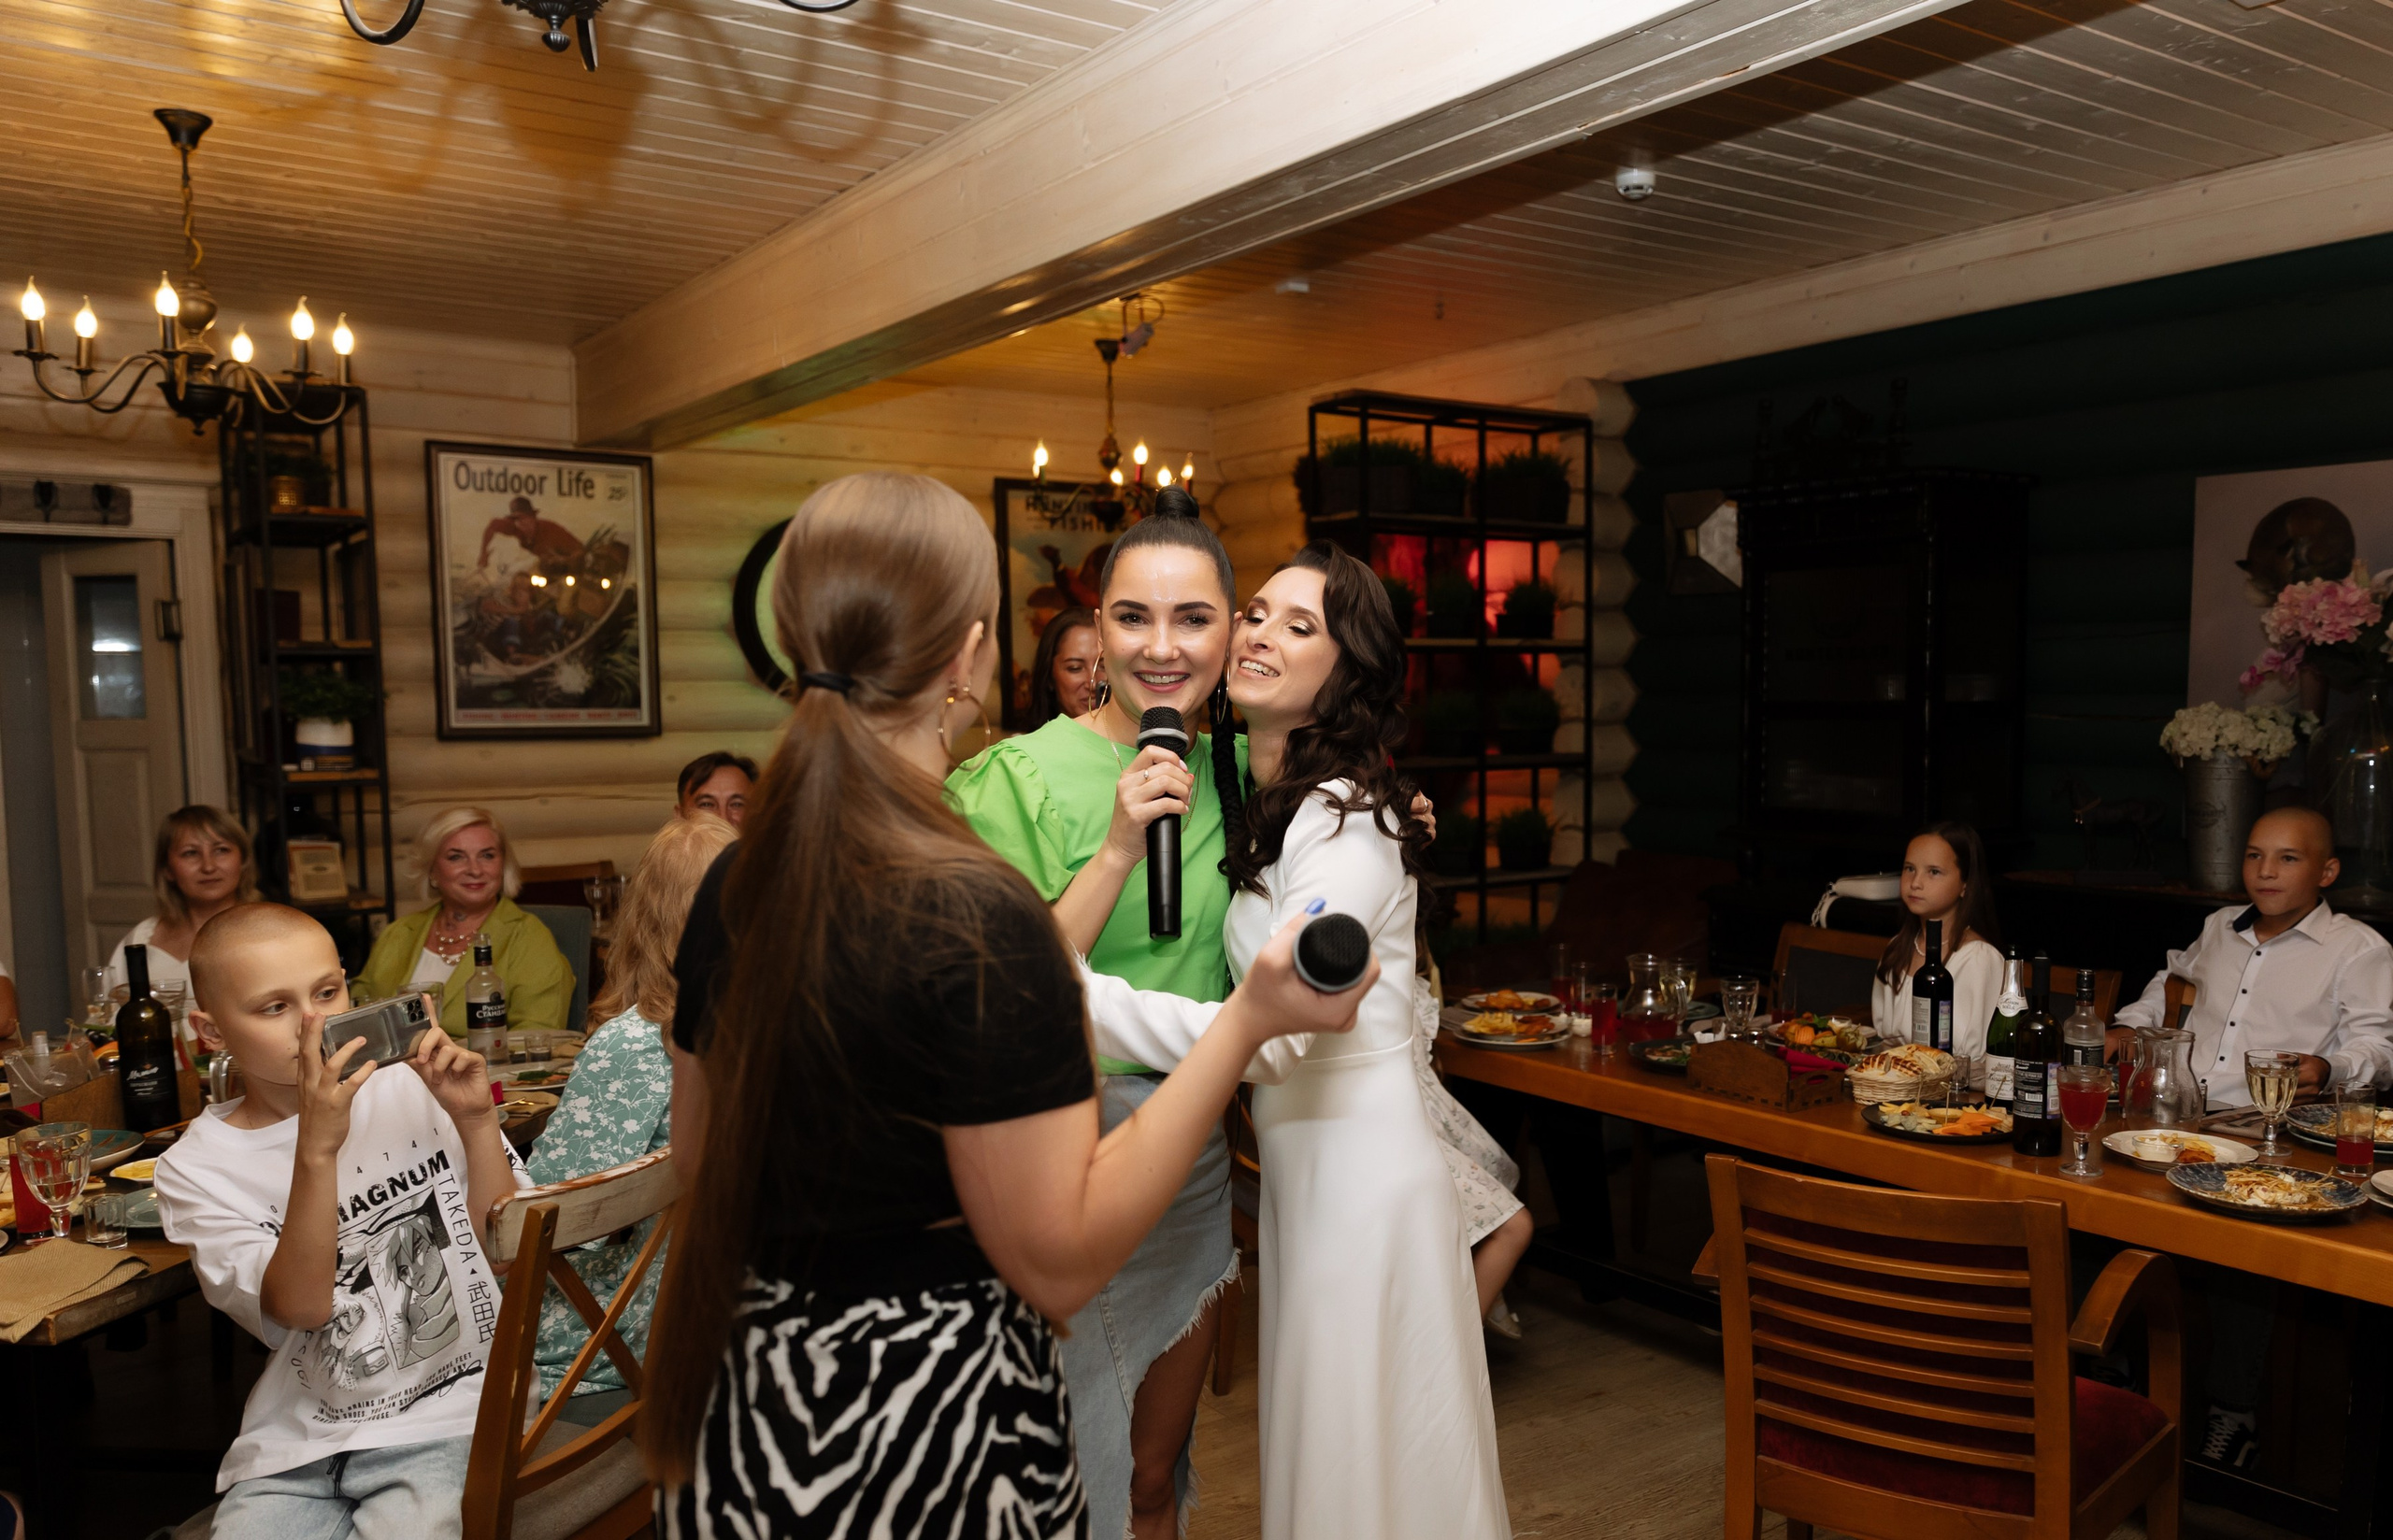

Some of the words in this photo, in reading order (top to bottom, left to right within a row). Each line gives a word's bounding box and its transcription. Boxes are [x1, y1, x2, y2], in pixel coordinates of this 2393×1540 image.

[454, 460, 547, 495] Outdoor
[557, 467, 595, 499] Life
[356, 1165, 363, 1174] 4
[383, 1152, 390, 1162] 7
[411, 1140, 418, 1148] 4
[433, 1127, 438, 1136] 1
[439, 1174, 477, 1263] TAKEDA
[384, 1402, 396, 1410] CAN
[453, 1363, 466, 1374] ANY
[388, 1391, 402, 1400] YOUR
[426, 1372, 436, 1383] YOU
[437, 1361, 453, 1374] HAVE
[455, 1352, 472, 1364] FEET
